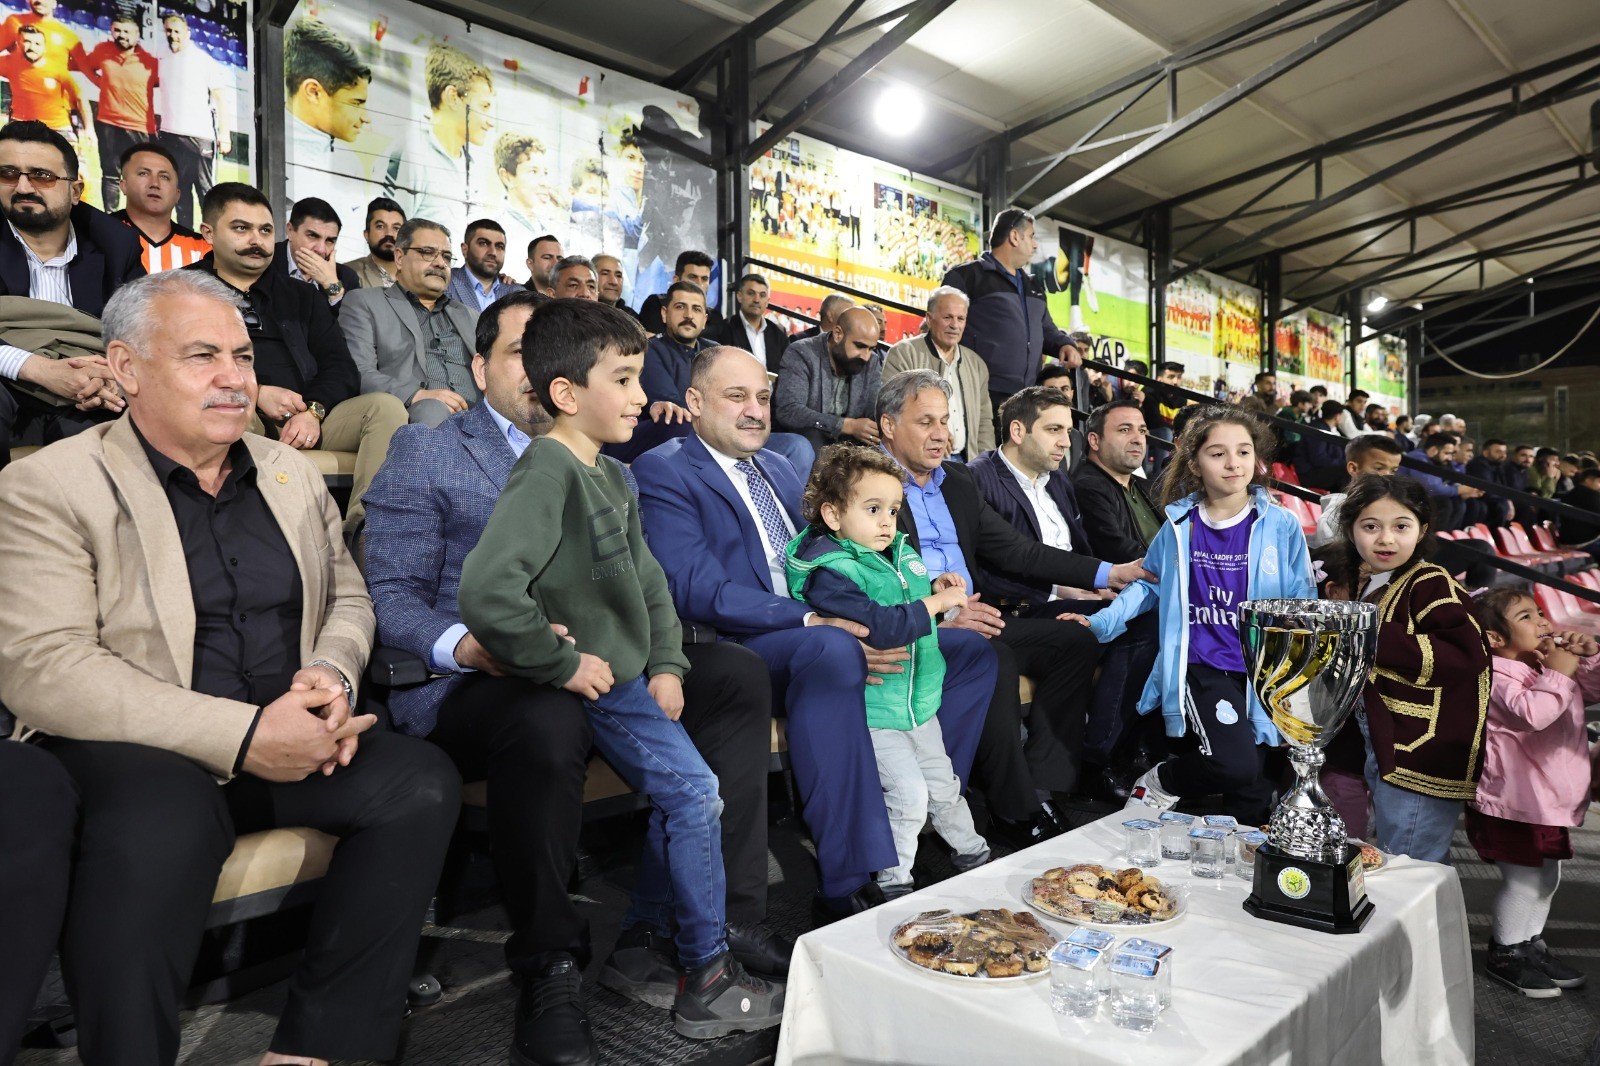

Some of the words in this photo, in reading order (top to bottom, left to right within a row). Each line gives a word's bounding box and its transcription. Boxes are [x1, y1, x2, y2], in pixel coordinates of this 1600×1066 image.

[750, 251, 817, 289] VOLEYBOL
[838, 269, 901, 300] BASKETBOL
[1089, 336, 1124, 366] YAP
[1194, 551, 1209, 559] FINAL
[1234, 554, 1248, 562] 2017
[1209, 585, 1233, 606] Fly
[1189, 603, 1238, 630] Emira
